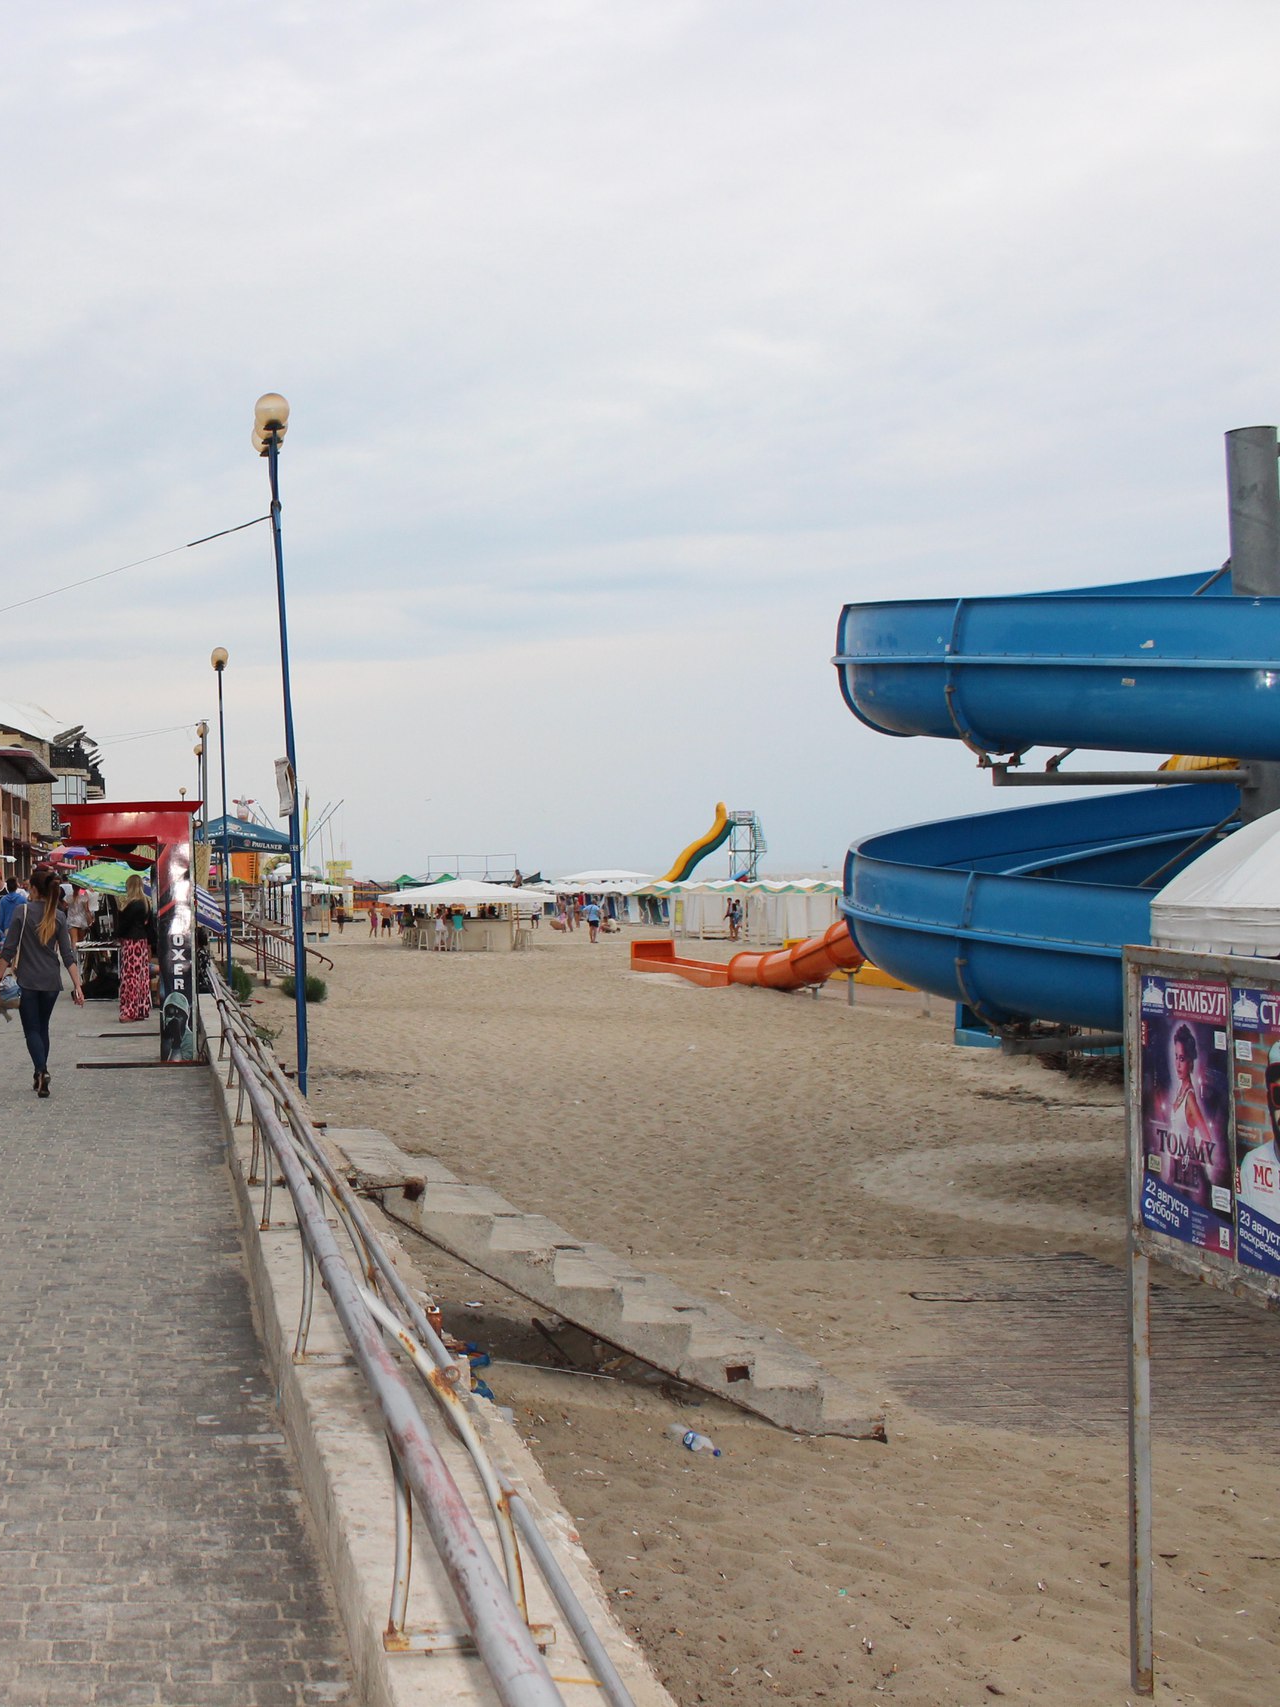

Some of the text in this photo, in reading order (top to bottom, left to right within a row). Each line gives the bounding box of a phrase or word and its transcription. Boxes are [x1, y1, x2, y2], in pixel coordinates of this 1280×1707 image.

[251, 841, 283, 850] PAULANER
[172, 934, 186, 990] OXER
[1165, 988, 1227, 1017] СТАМБУЛ
[1156, 1129, 1216, 1166] TOMMY
[1253, 1164, 1273, 1188] MC
[1145, 1179, 1156, 1195] 22
[1157, 1188, 1189, 1218] августа
[1145, 1198, 1180, 1228] суббота
[1239, 1227, 1280, 1261] воскресень
[1240, 1210, 1250, 1227] 23
[1251, 1220, 1280, 1246] август
